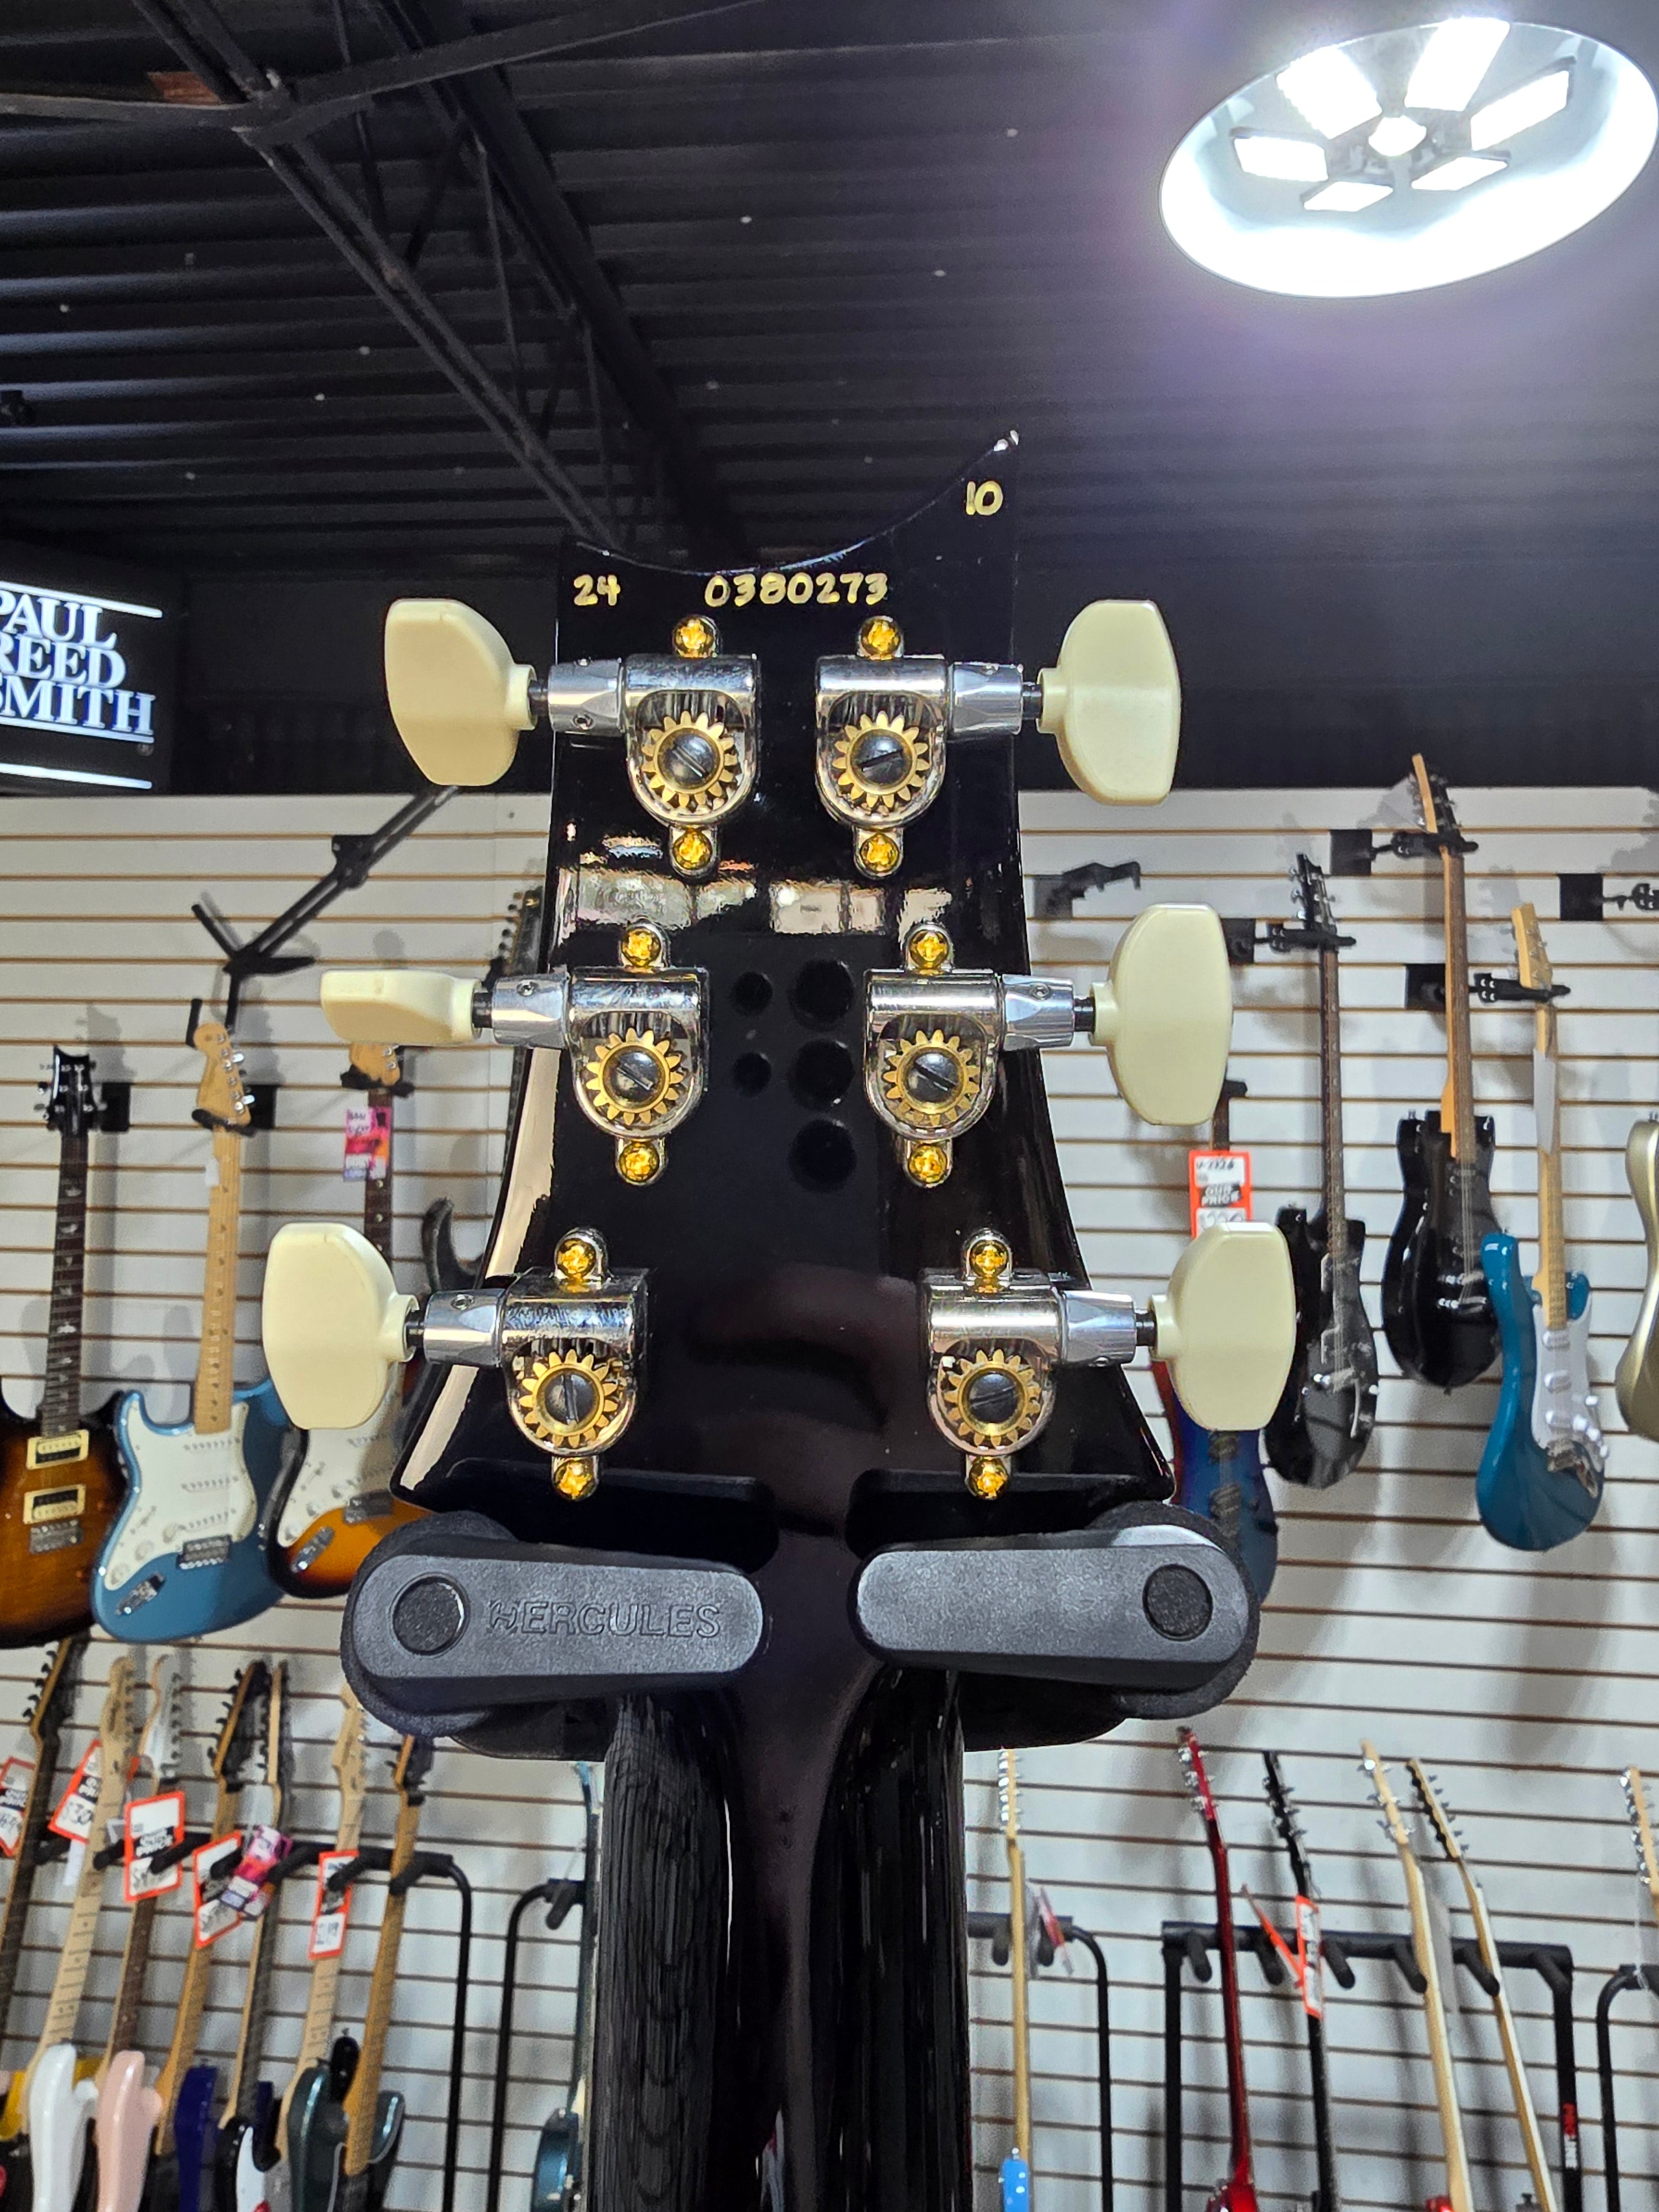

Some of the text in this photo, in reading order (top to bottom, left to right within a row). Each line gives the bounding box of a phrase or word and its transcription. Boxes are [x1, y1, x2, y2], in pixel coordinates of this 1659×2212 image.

[965, 481, 1004, 515] 10
[573, 572, 888, 607] 24 0380273
[0, 672, 156, 735] MITH
[488, 1600, 721, 1638] HERCULES
